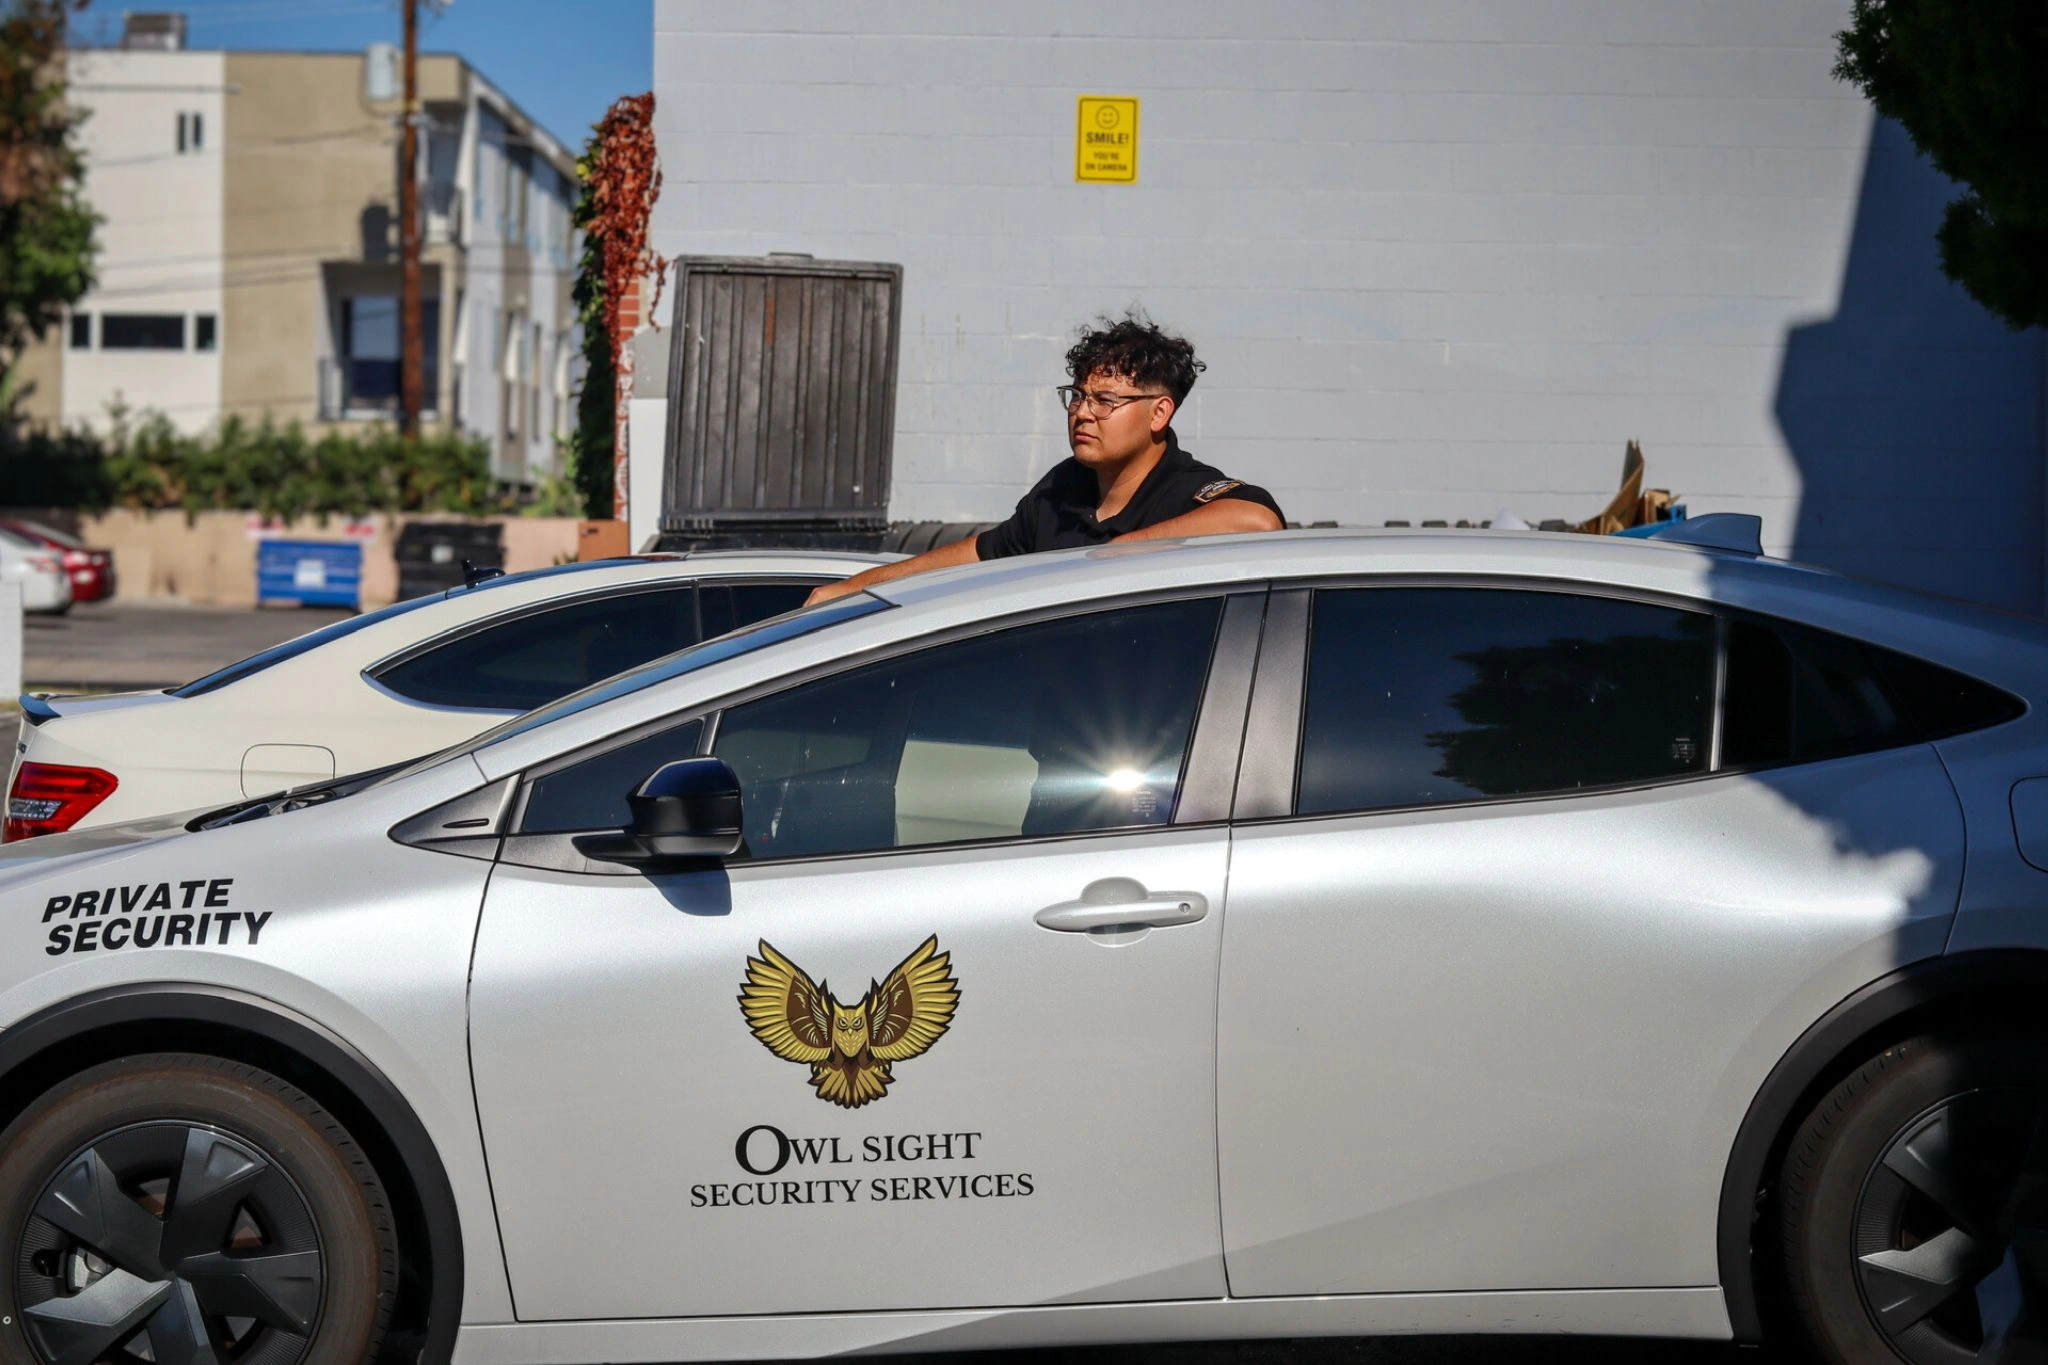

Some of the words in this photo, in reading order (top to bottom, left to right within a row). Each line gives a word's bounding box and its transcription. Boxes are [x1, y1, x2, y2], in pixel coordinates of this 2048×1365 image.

[1086, 132, 1129, 145] SMILE!
[1085, 162, 1096, 171] ON
[1097, 163, 1128, 172] CAMERA
[1093, 152, 1120, 161] YOU'RE
[41, 878, 234, 923] PRIVATE
[45, 911, 273, 956] SECURITY
[862, 1132, 982, 1163] SIGHT
[690, 1179, 862, 1208] SECURITY
[870, 1173, 1035, 1202] SERVICES
